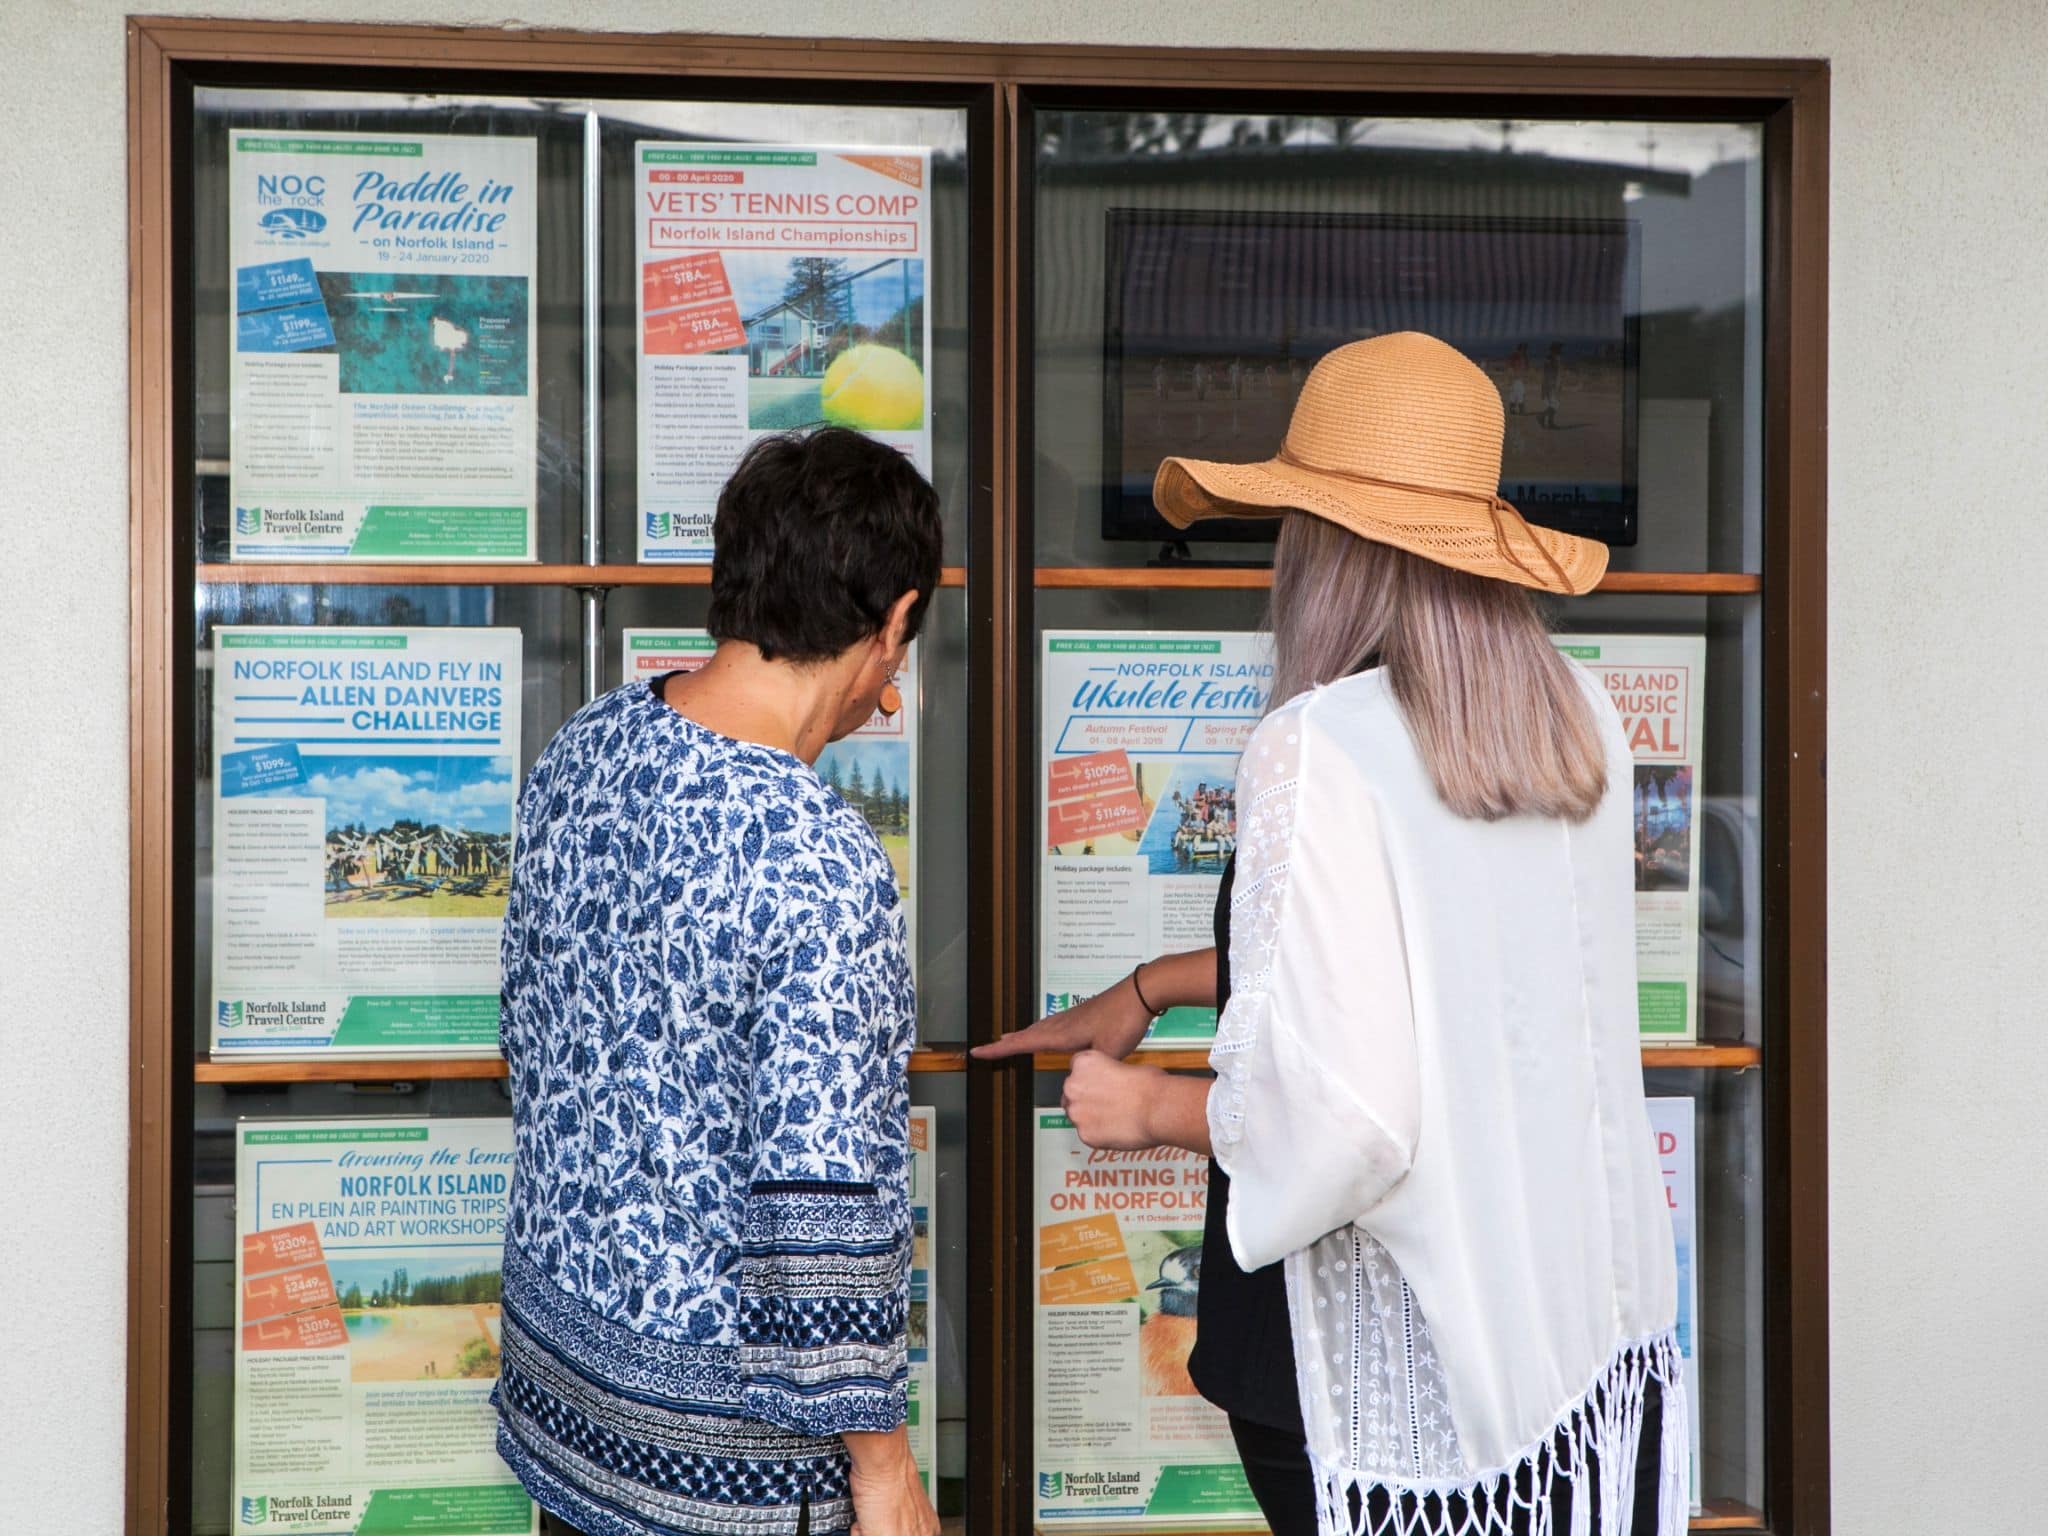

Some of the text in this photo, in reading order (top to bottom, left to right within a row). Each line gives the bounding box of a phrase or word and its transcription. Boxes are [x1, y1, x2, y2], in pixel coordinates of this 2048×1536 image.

[258, 175, 326, 196] NOC
[690, 173, 711, 184] April
[352, 171, 514, 204] Paddle in
[291, 194, 325, 207] rock
[646, 192, 919, 216] VETS' TENNIS COMP
[352, 201, 507, 233] Paradise
[372, 235, 494, 250] on Norfolk Island
[660, 226, 908, 245] Norfolk Island Championships
[378, 252, 489, 265] 19 24 January 2020
[270, 272, 299, 288] $1149
[674, 269, 702, 286] $TBA
[283, 319, 310, 333] $1199
[691, 317, 721, 334] $TBA
[264, 509, 344, 522] Norfolk Island
[673, 514, 712, 525] Norfolk
[264, 522, 343, 535] Travel Centre
[673, 526, 709, 537] Travel
[234, 660, 501, 681] NORFOLK ISLAND FLY IN
[667, 659, 704, 669] February
[1118, 663, 1274, 677] NORFOLK ISLAND
[1604, 673, 1679, 691] ISLAND
[300, 686, 502, 707] ALLEN DANVERS
[1072, 680, 1187, 712] Ukulele
[1610, 695, 1678, 714] MUSIC
[352, 710, 501, 731] CHALLENGE
[1085, 723, 1168, 734] Autumn Festival
[1204, 724, 1239, 736] Spring
[1120, 736, 1142, 748] April
[256, 758, 284, 773] $1099
[1084, 763, 1116, 780] $1099
[1095, 806, 1126, 823] $1149
[1054, 865, 1077, 874] Holiday
[1078, 866, 1104, 875] package
[246, 1001, 326, 1013] Norfolk Island
[246, 1014, 325, 1026] Travel Centre
[338, 1150, 423, 1170] Arousing
[429, 1147, 459, 1166] the
[341, 1174, 506, 1197] NORFOLK ISLAND
[1065, 1168, 1175, 1188] PAINTING
[272, 1198, 506, 1219] EN PLEIN AIR PAINTING TRIPS
[1050, 1191, 1206, 1210] ON NORFOLK
[1146, 1213, 1180, 1222] October
[324, 1217, 506, 1237] AND ART WORKSHOPS
[273, 1235, 306, 1252] $2309
[285, 1277, 318, 1294] $2449
[1065, 1472, 1140, 1484] Norfolk Island
[1065, 1484, 1139, 1496] Travel Centre
[270, 1495, 352, 1509] Norfolk Island
[270, 1509, 350, 1523] Travel Centre
